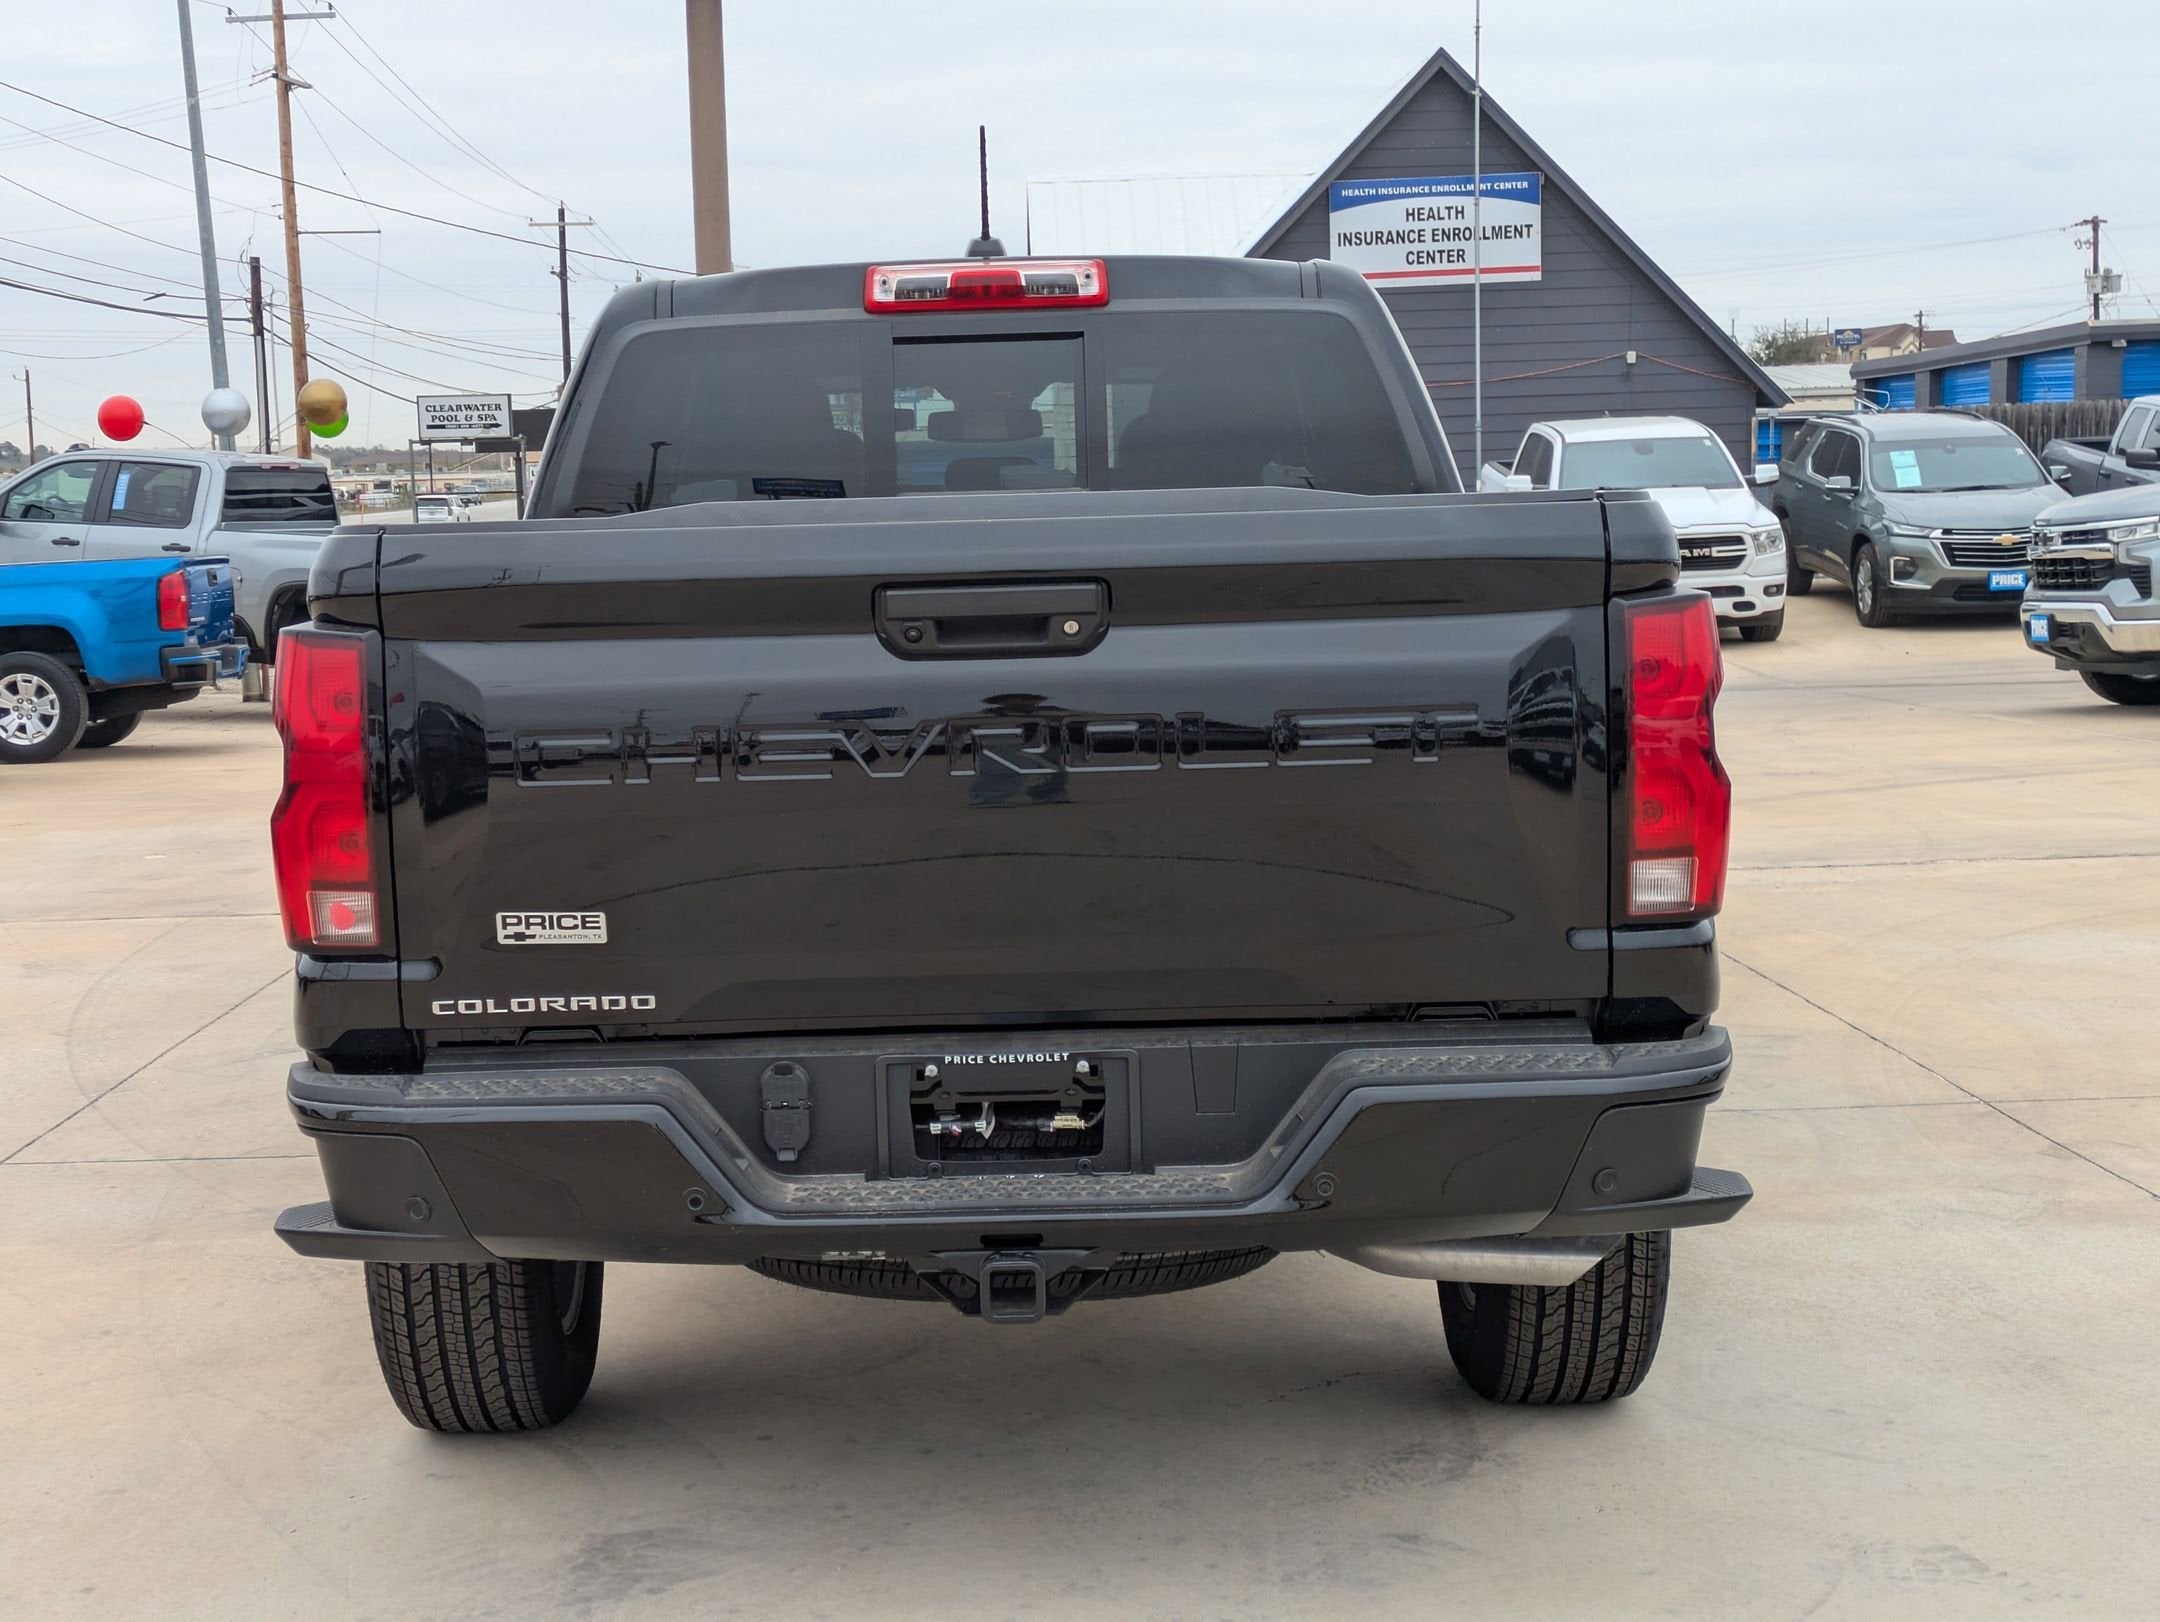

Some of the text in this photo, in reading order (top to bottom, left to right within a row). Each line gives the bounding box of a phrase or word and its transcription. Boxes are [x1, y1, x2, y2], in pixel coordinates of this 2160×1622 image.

[1341, 181, 1529, 197] HEALTH INSURANCE ENROLLMNT CENTER
[1405, 205, 1465, 222] HEALTH
[1337, 229, 1426, 247] INSURANCE
[1405, 248, 1466, 266] CENTER
[425, 403, 502, 412] CLEARWATER
[431, 413, 497, 423] POOL & SPA
[1992, 573, 2024, 585] PRICE
[514, 703, 1479, 786] CHEVROLET
[501, 914, 602, 930] PRICE
[432, 995, 656, 1015] COLORADO
[944, 1052, 1070, 1064] PRICE CHEVROLET
